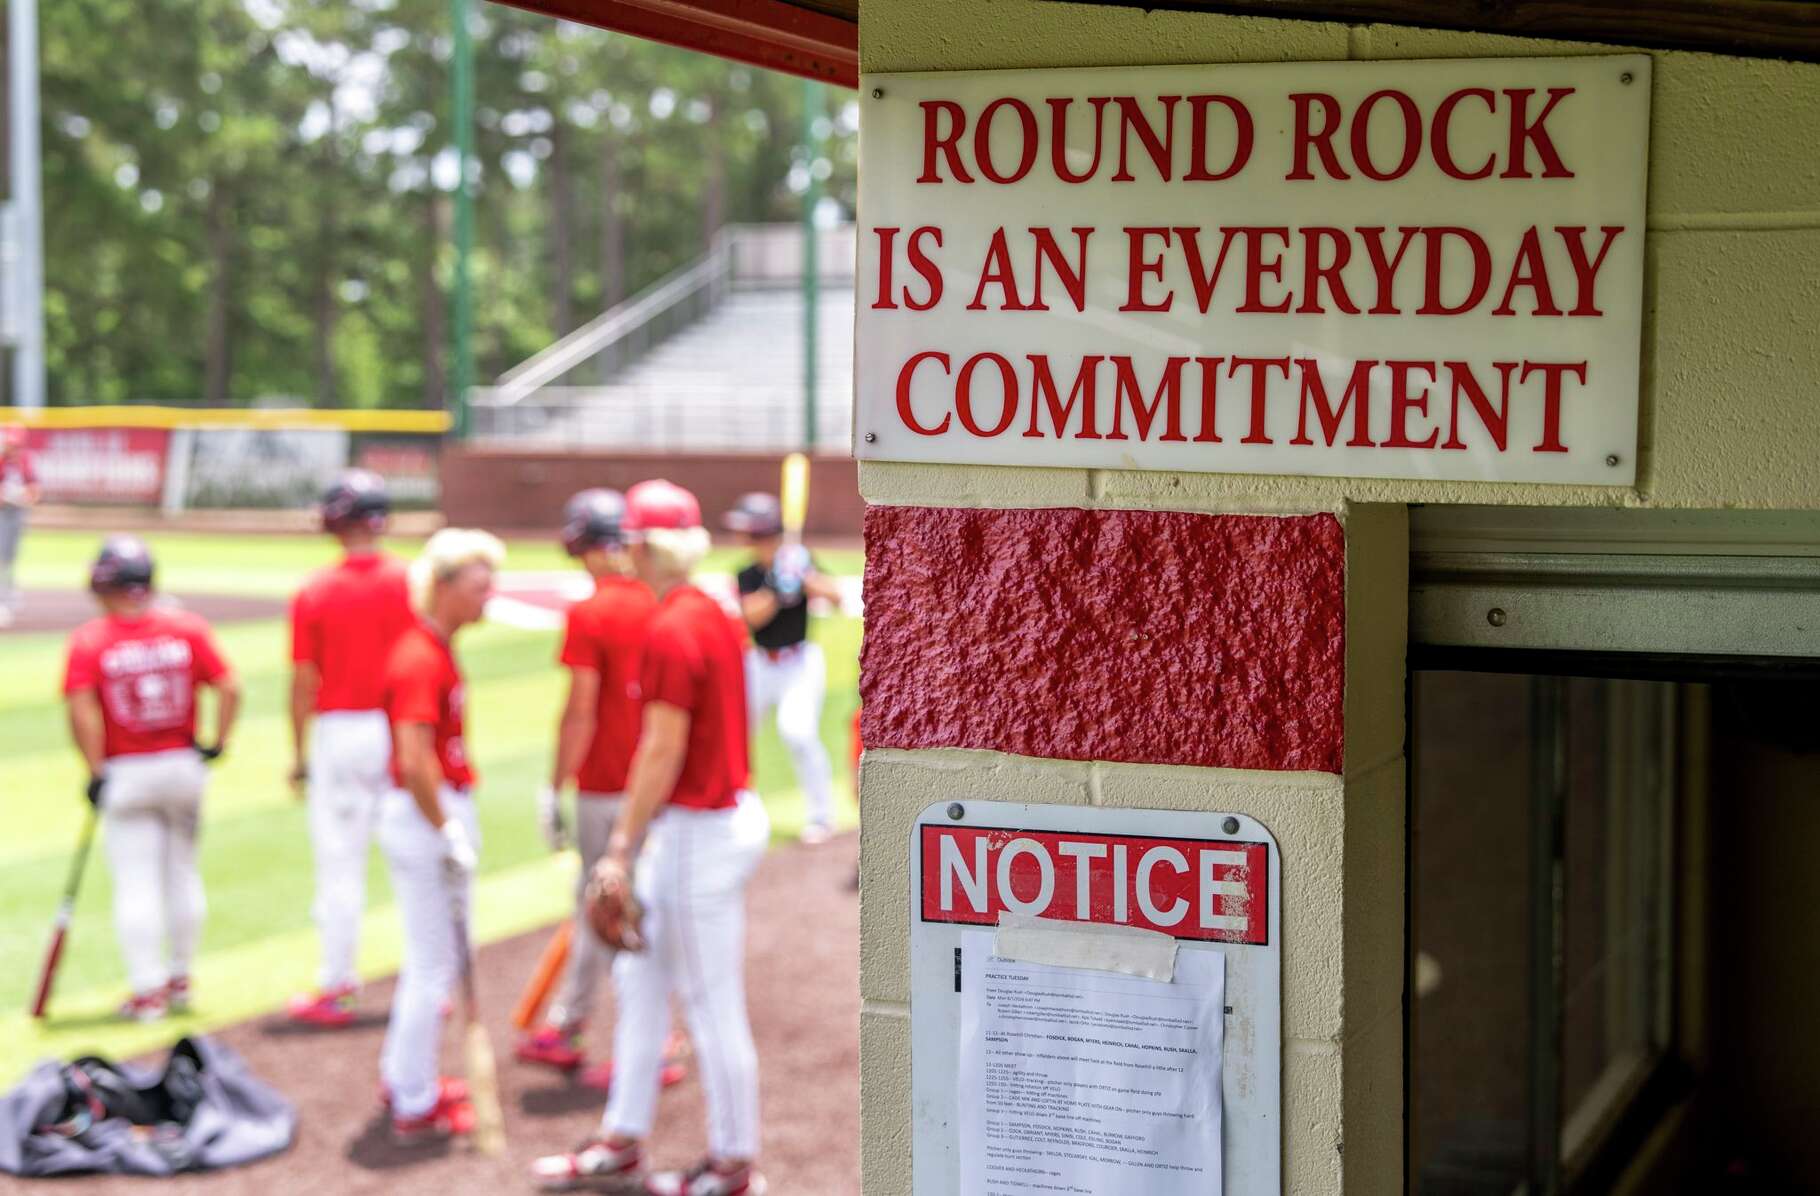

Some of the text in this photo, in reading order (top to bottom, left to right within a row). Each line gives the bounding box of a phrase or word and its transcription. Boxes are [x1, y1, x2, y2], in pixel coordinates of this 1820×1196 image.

[917, 88, 1575, 184] ROUND ROCK
[870, 225, 1624, 317] IS AN EVERYDAY
[896, 351, 1589, 453] COMMITMENT
[939, 833, 1249, 931] NOTICE
